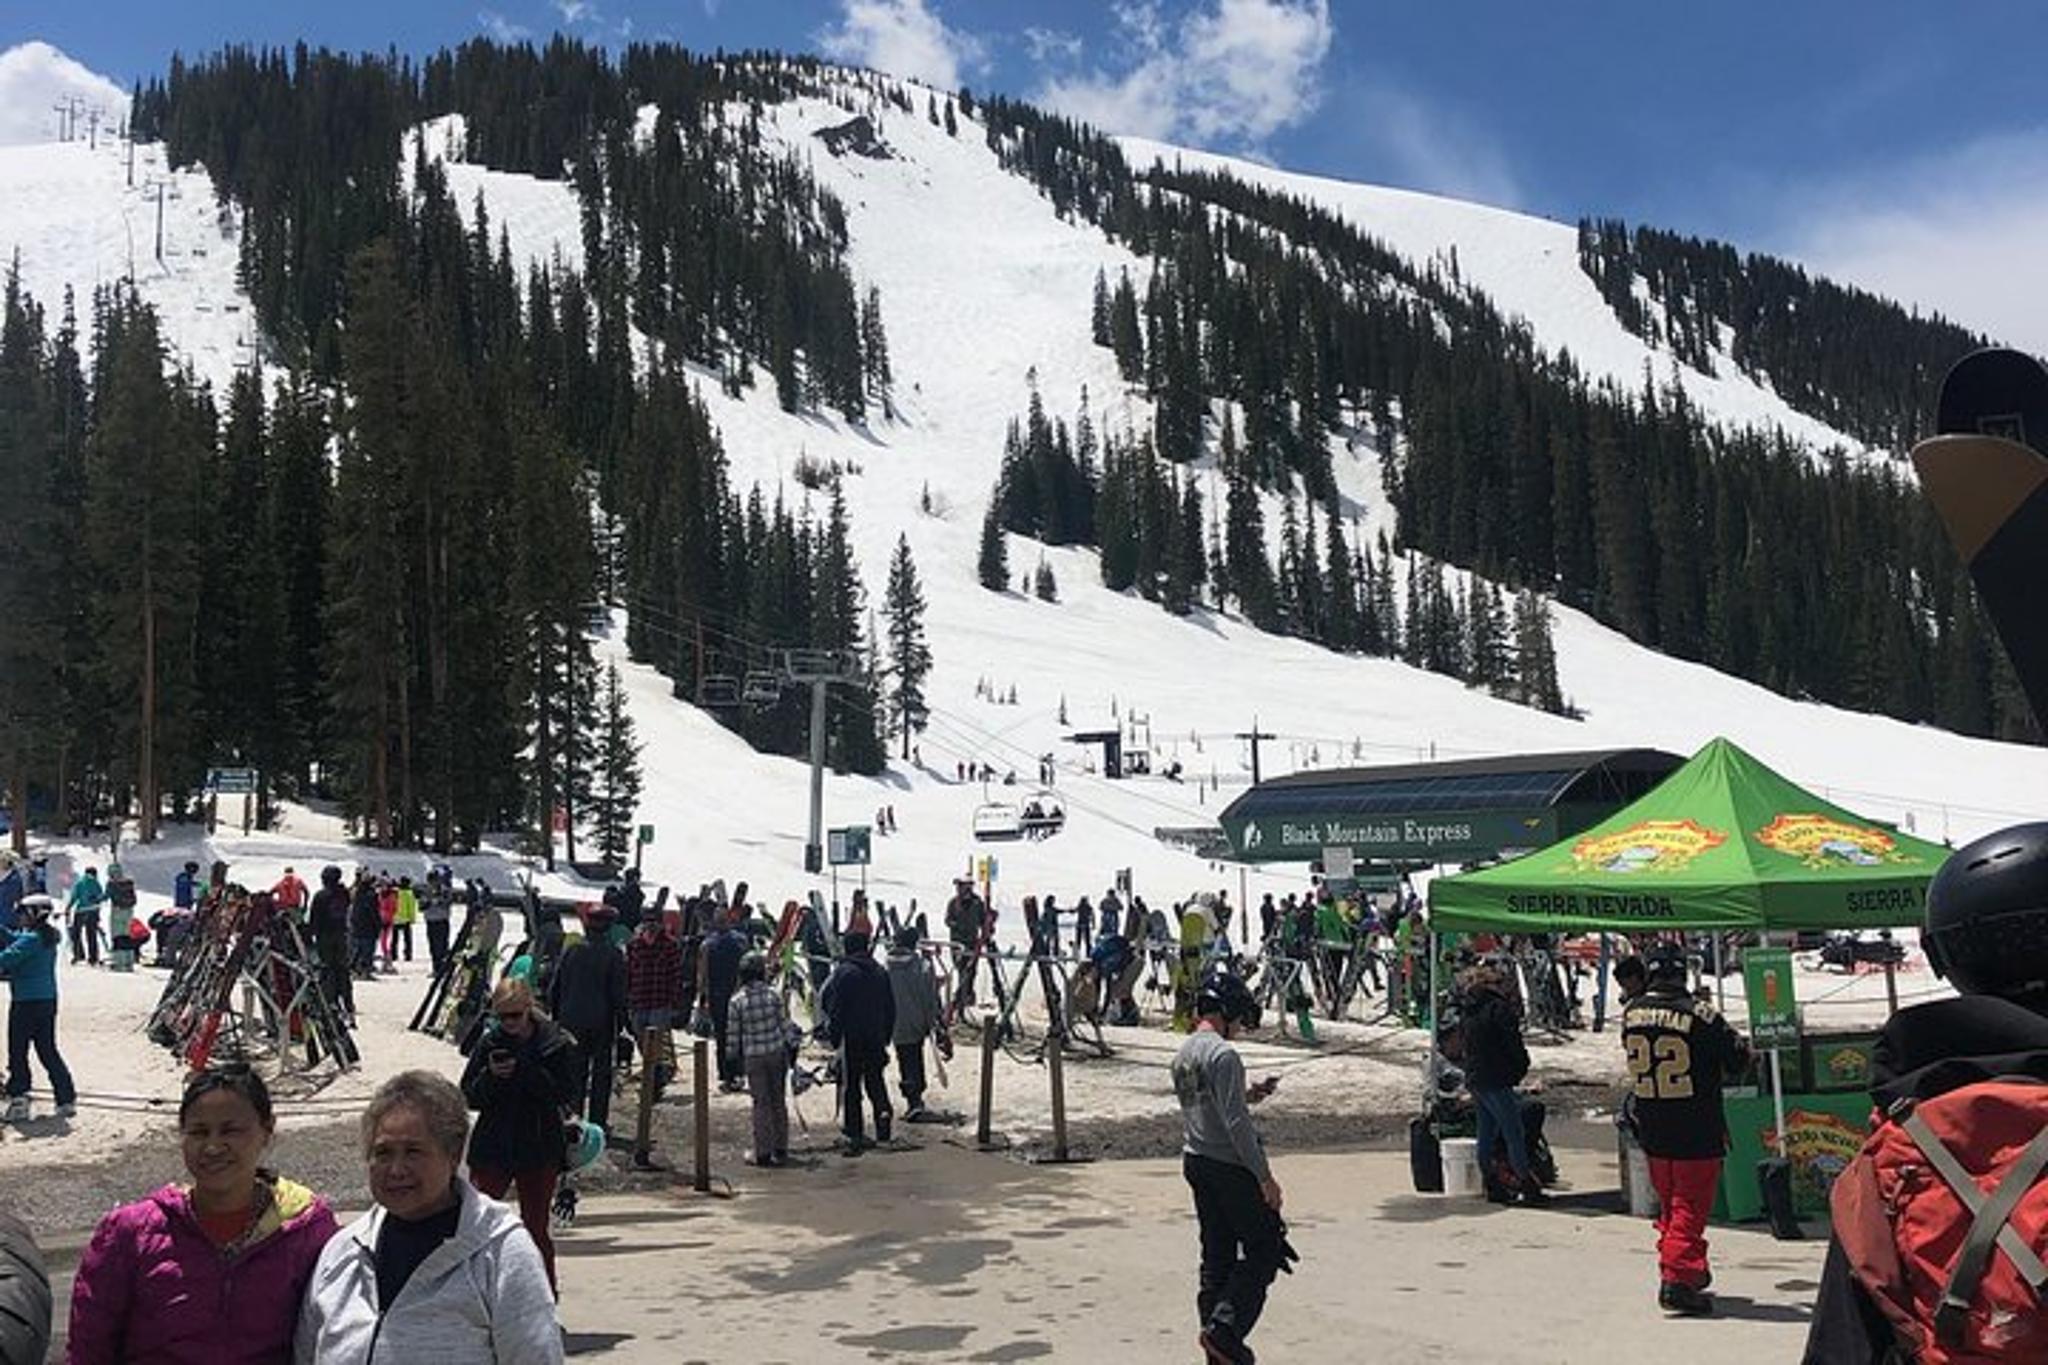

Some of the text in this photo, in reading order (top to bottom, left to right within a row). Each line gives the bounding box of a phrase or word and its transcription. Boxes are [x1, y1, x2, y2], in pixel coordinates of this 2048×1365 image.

[1282, 819, 1471, 846] Black Mountain Express
[1507, 893, 1675, 916] SIERRA NEVADA
[1845, 887, 1917, 913] SIERRA
[1626, 1033, 1694, 1099] 22
